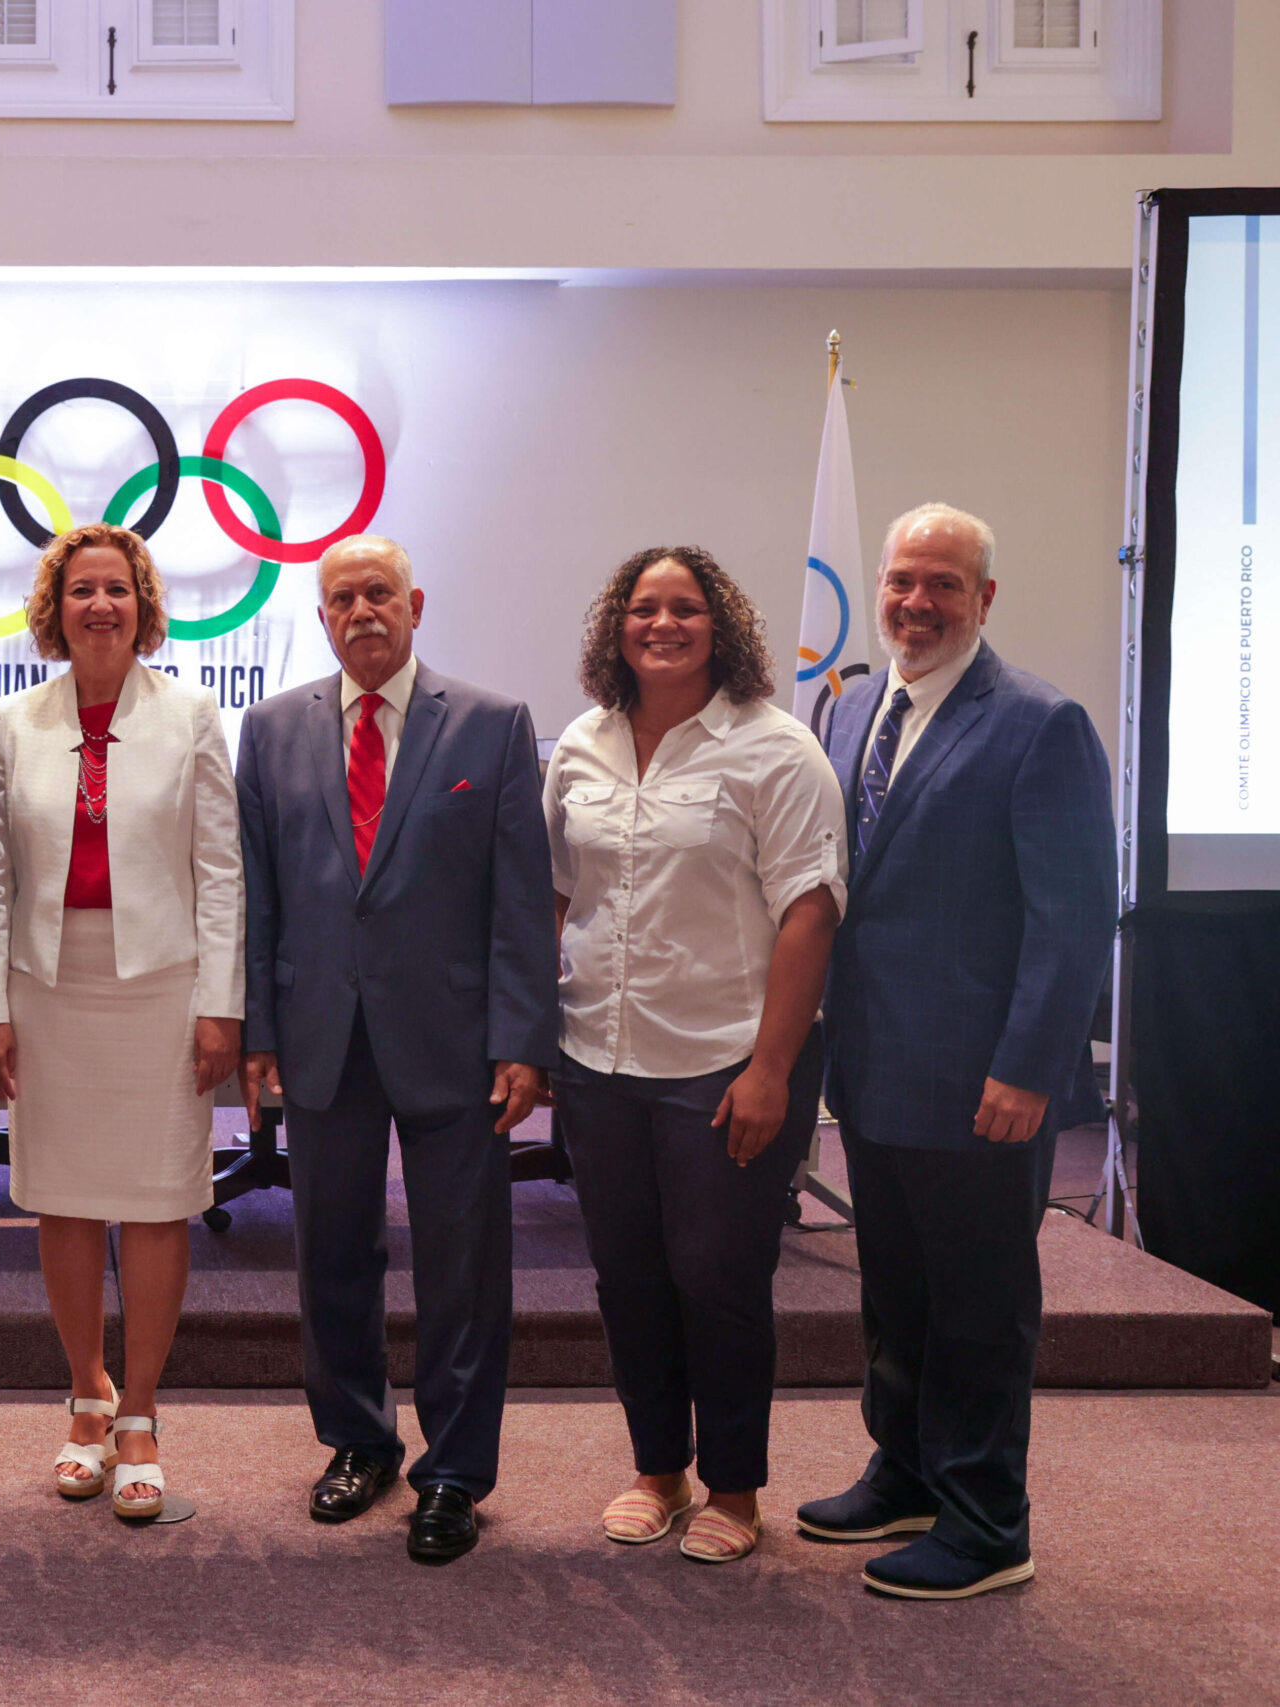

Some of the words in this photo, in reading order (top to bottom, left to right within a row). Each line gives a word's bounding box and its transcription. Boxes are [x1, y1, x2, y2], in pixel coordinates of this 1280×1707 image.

[1240, 544, 1253, 582] RICO
[1239, 587, 1252, 648] PUERTO
[1239, 652, 1252, 673] DE
[1236, 677, 1251, 751] OLÍMPICO
